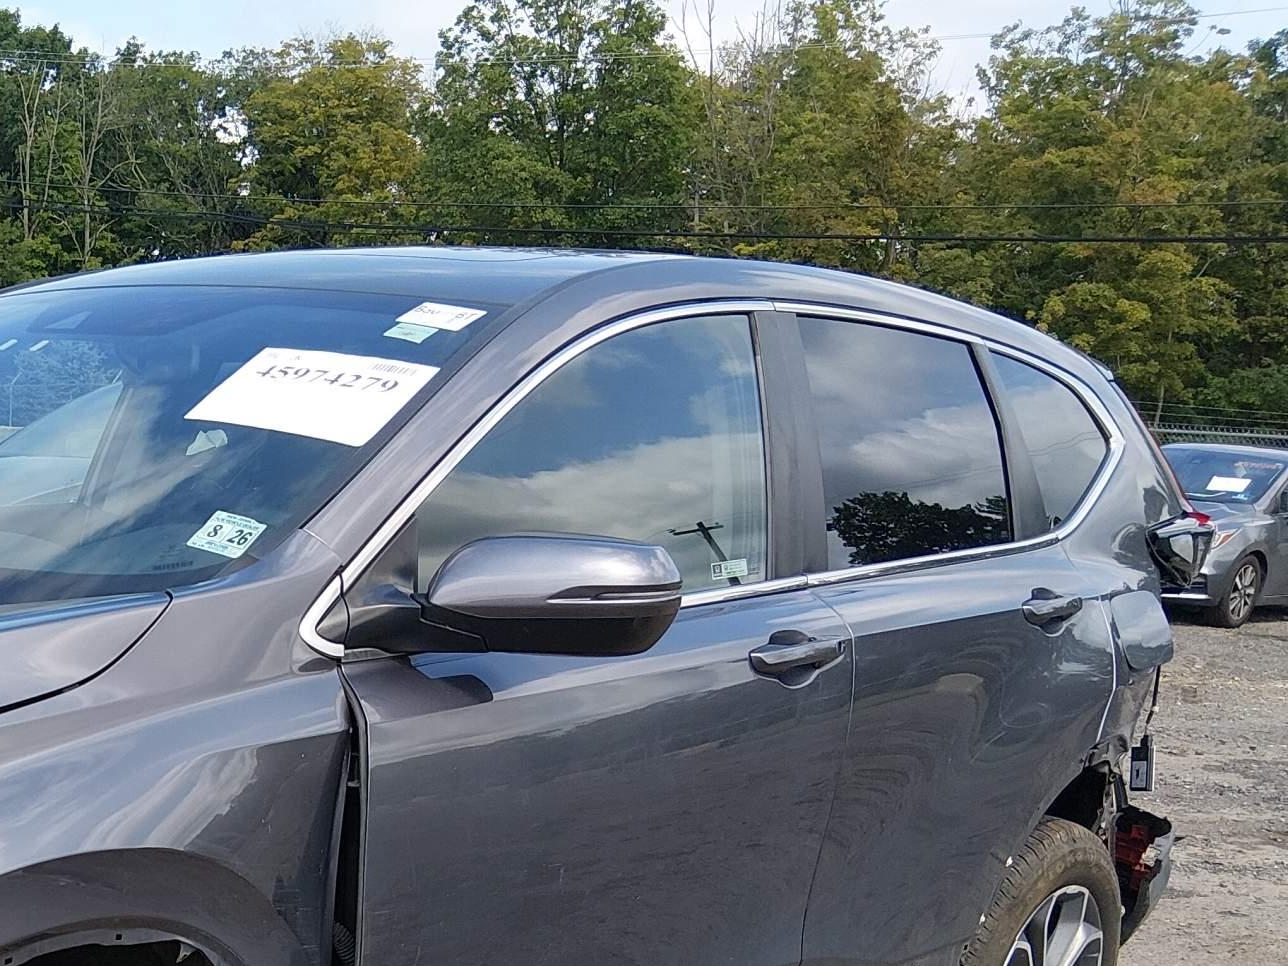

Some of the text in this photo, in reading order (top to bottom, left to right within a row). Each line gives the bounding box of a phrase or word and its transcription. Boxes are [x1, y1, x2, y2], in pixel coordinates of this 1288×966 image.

[256, 364, 400, 393] 45974279
[206, 524, 253, 546] 8 26
